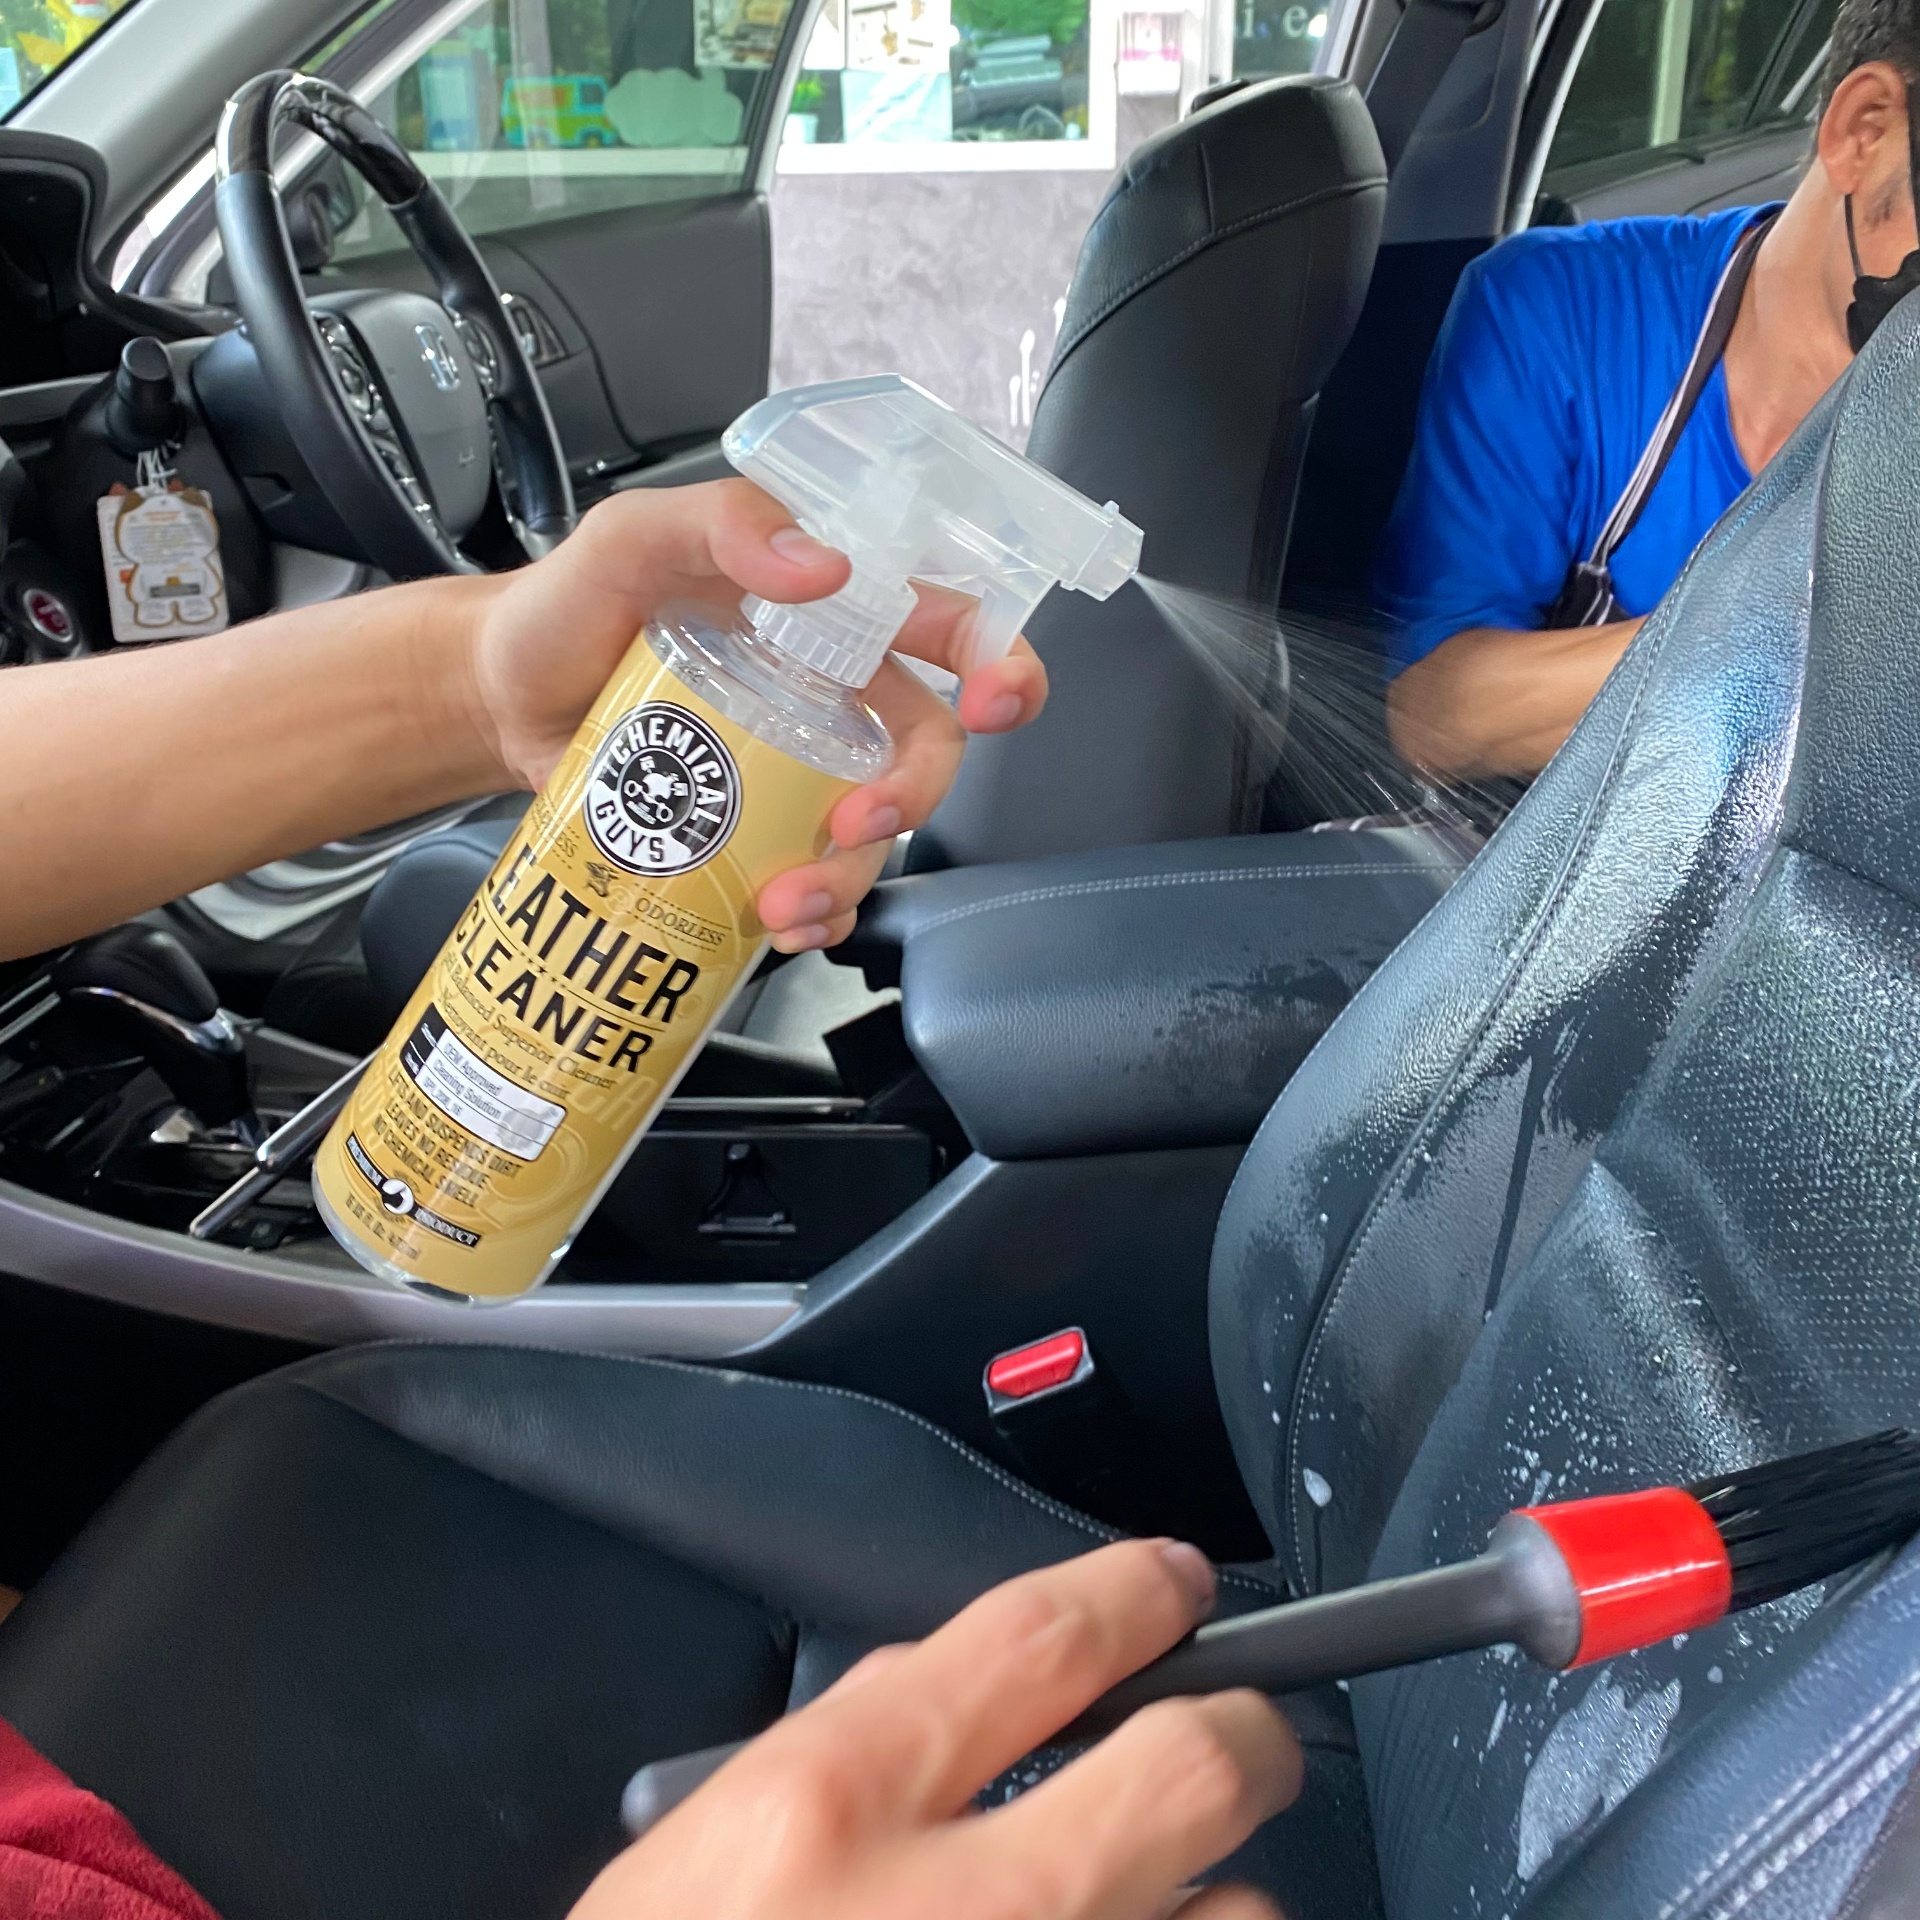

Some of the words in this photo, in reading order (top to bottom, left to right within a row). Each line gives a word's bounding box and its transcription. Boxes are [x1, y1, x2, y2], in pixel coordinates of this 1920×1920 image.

[609, 716, 728, 825] CHEMICAL
[595, 799, 665, 863] GUYS
[486, 826, 700, 1024] LEATHER
[634, 896, 726, 947] ODORLESS
[456, 899, 655, 1074] CLEANER
[484, 1047, 523, 1076] pour
[523, 1066, 539, 1085] le
[491, 1013, 556, 1065] Superior
[557, 1055, 617, 1090] Cleaner
[432, 1059, 464, 1095] Cleaning
[463, 1085, 503, 1119] Solution
[383, 1128, 435, 1185] CHEMICAL
[424, 1112, 490, 1165] SUSPENDS
